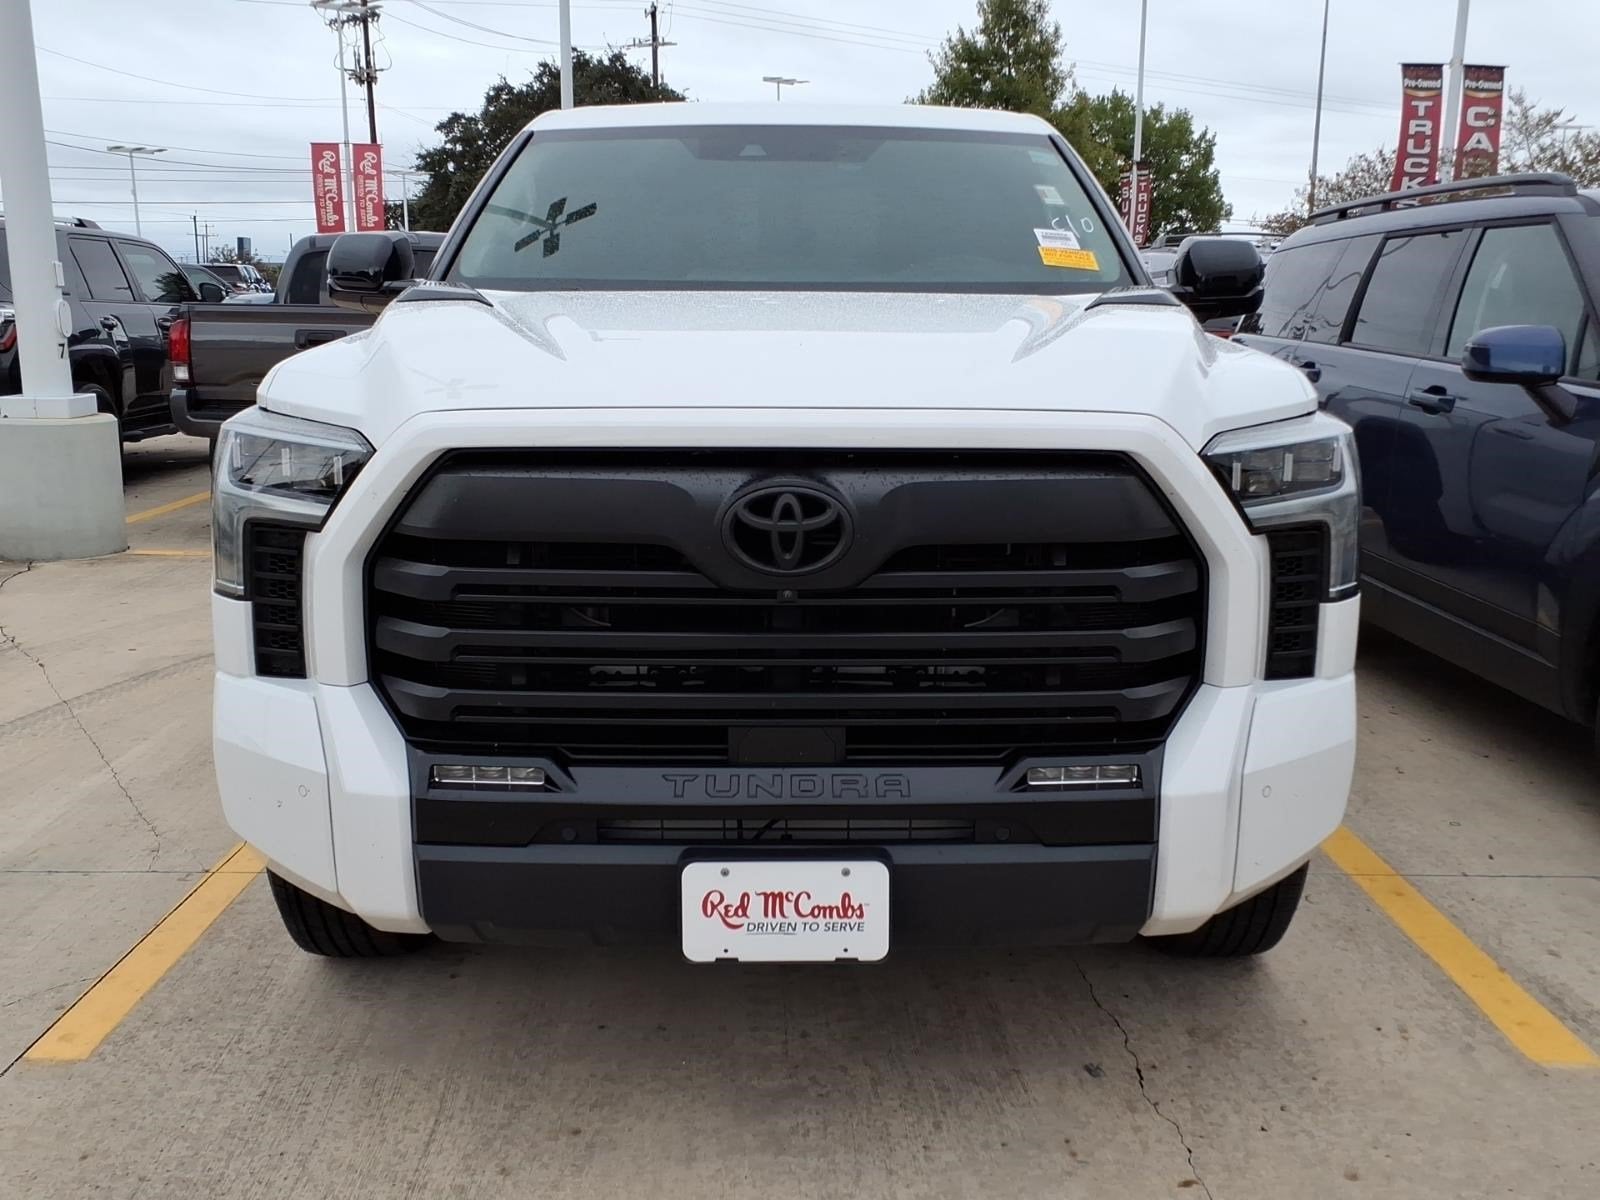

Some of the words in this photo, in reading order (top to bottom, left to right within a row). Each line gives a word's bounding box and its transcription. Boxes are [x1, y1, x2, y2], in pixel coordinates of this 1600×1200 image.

[1461, 106, 1497, 178] CA
[319, 150, 336, 174] Red
[359, 151, 378, 175] Red
[365, 176, 379, 227] McCombs
[1134, 182, 1147, 243] TRUCKS
[58, 343, 66, 359] 7
[662, 774, 911, 798] TUNDRA
[702, 889, 750, 929] Red
[755, 891, 864, 919] McCombs
[746, 921, 797, 933] DRIVEN
[801, 921, 819, 932] TO
[823, 921, 864, 932] SERVE
